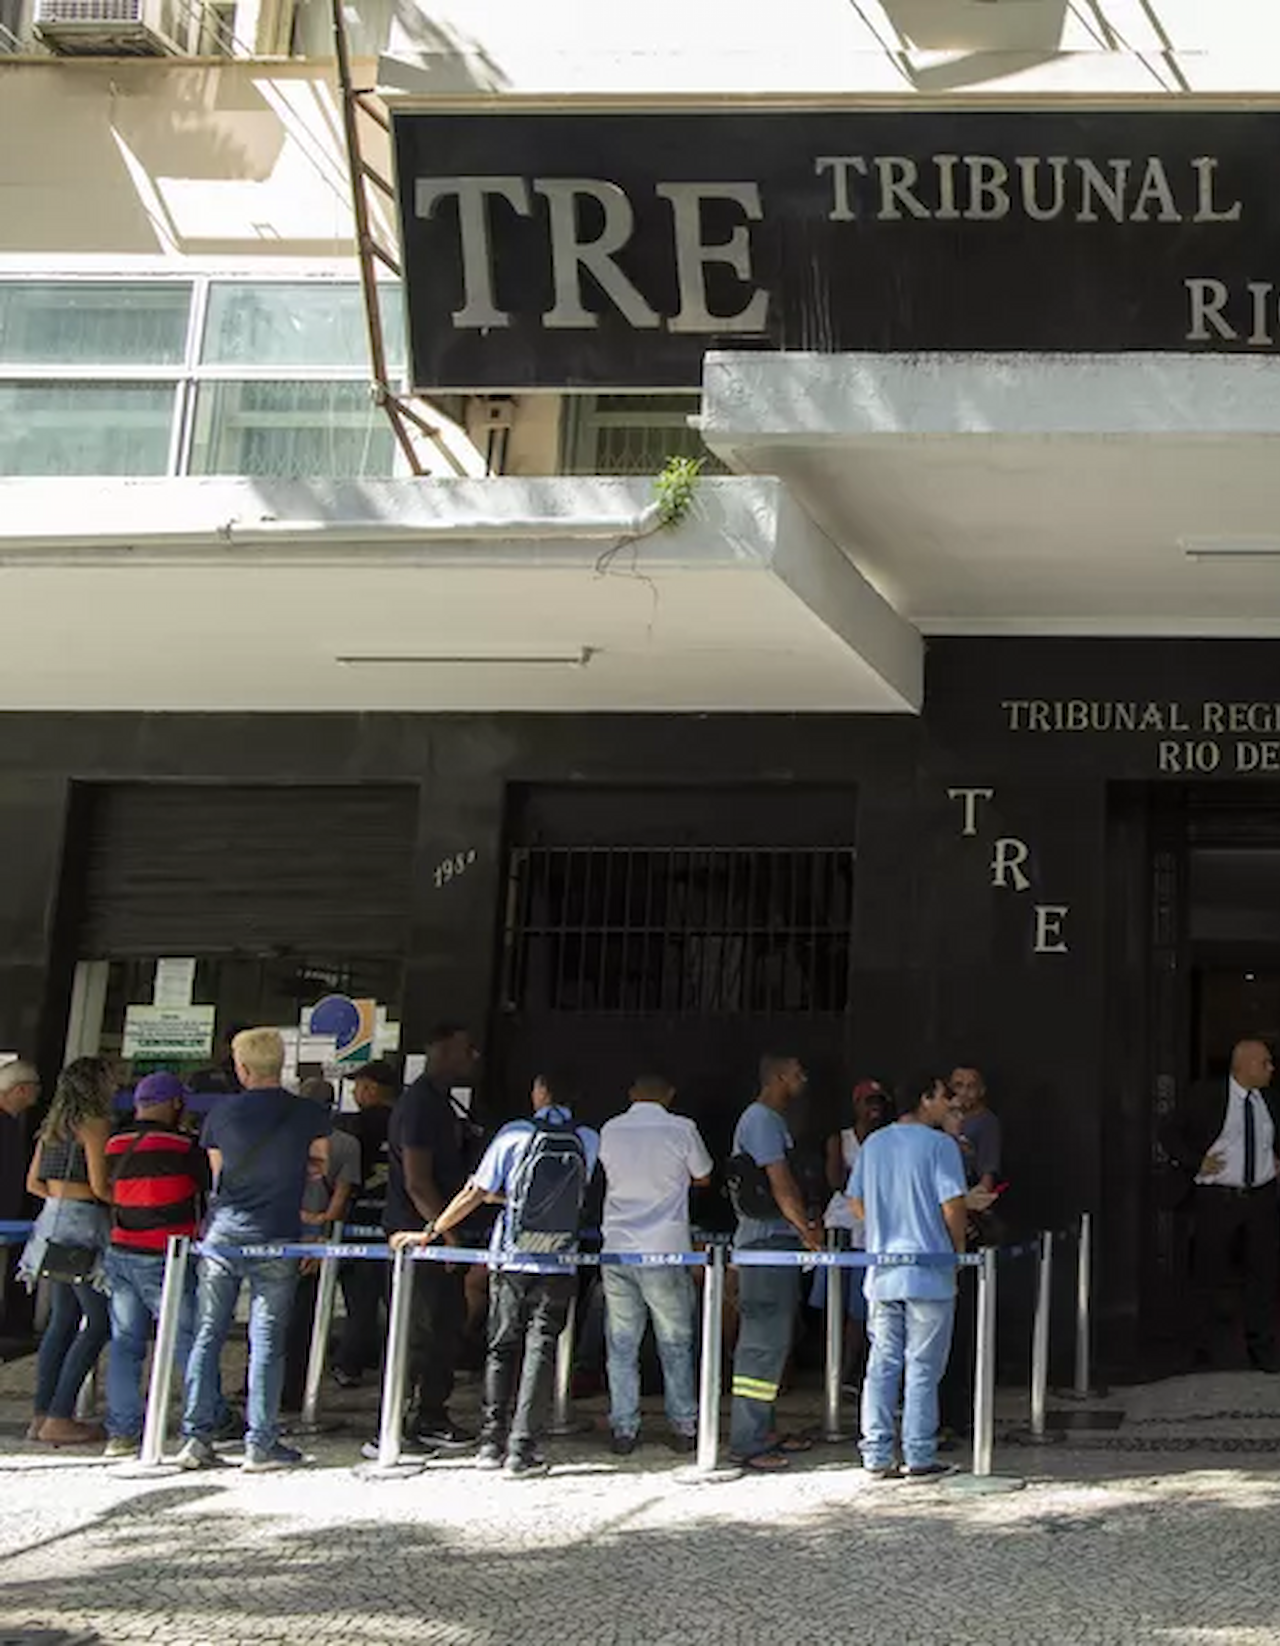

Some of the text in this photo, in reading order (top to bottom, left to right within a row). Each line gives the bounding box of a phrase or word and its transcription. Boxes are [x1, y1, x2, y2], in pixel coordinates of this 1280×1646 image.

[814, 155, 1243, 223] TRIBUNAL
[414, 175, 770, 334] TRE
[1001, 700, 1190, 732] TRIBUNAL
[1157, 740, 1220, 773] RIO
[1234, 741, 1280, 770] DE
